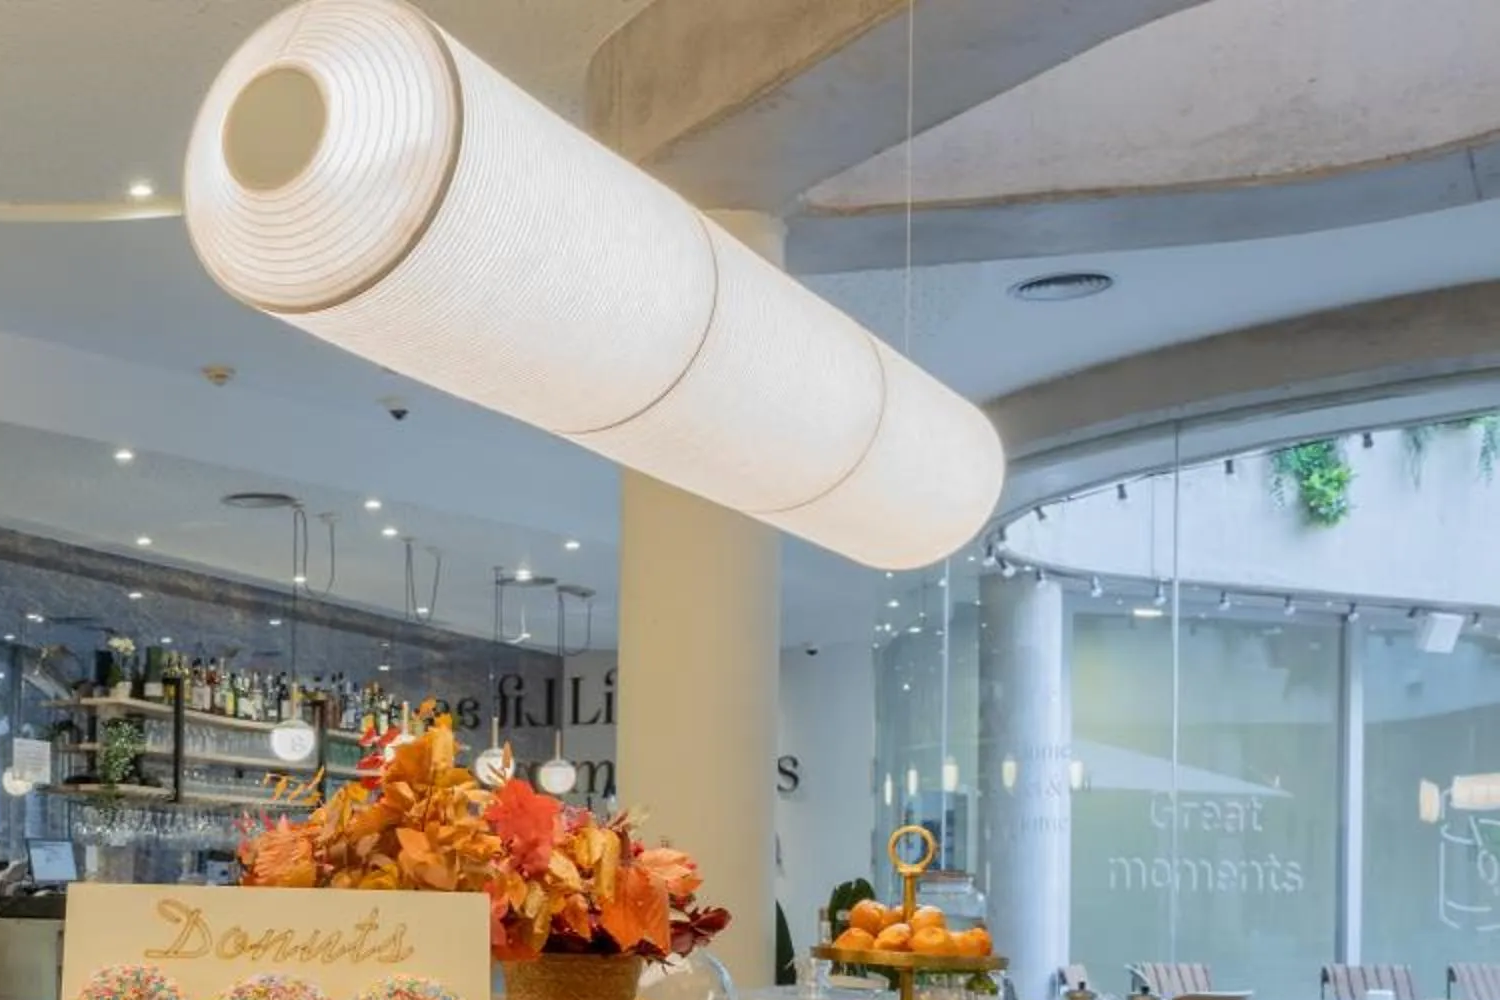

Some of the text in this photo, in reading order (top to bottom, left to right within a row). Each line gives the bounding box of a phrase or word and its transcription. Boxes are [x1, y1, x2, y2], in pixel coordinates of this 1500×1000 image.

[1151, 791, 1264, 832] Great
[1108, 853, 1304, 893] moments
[143, 899, 416, 964] Donuts
